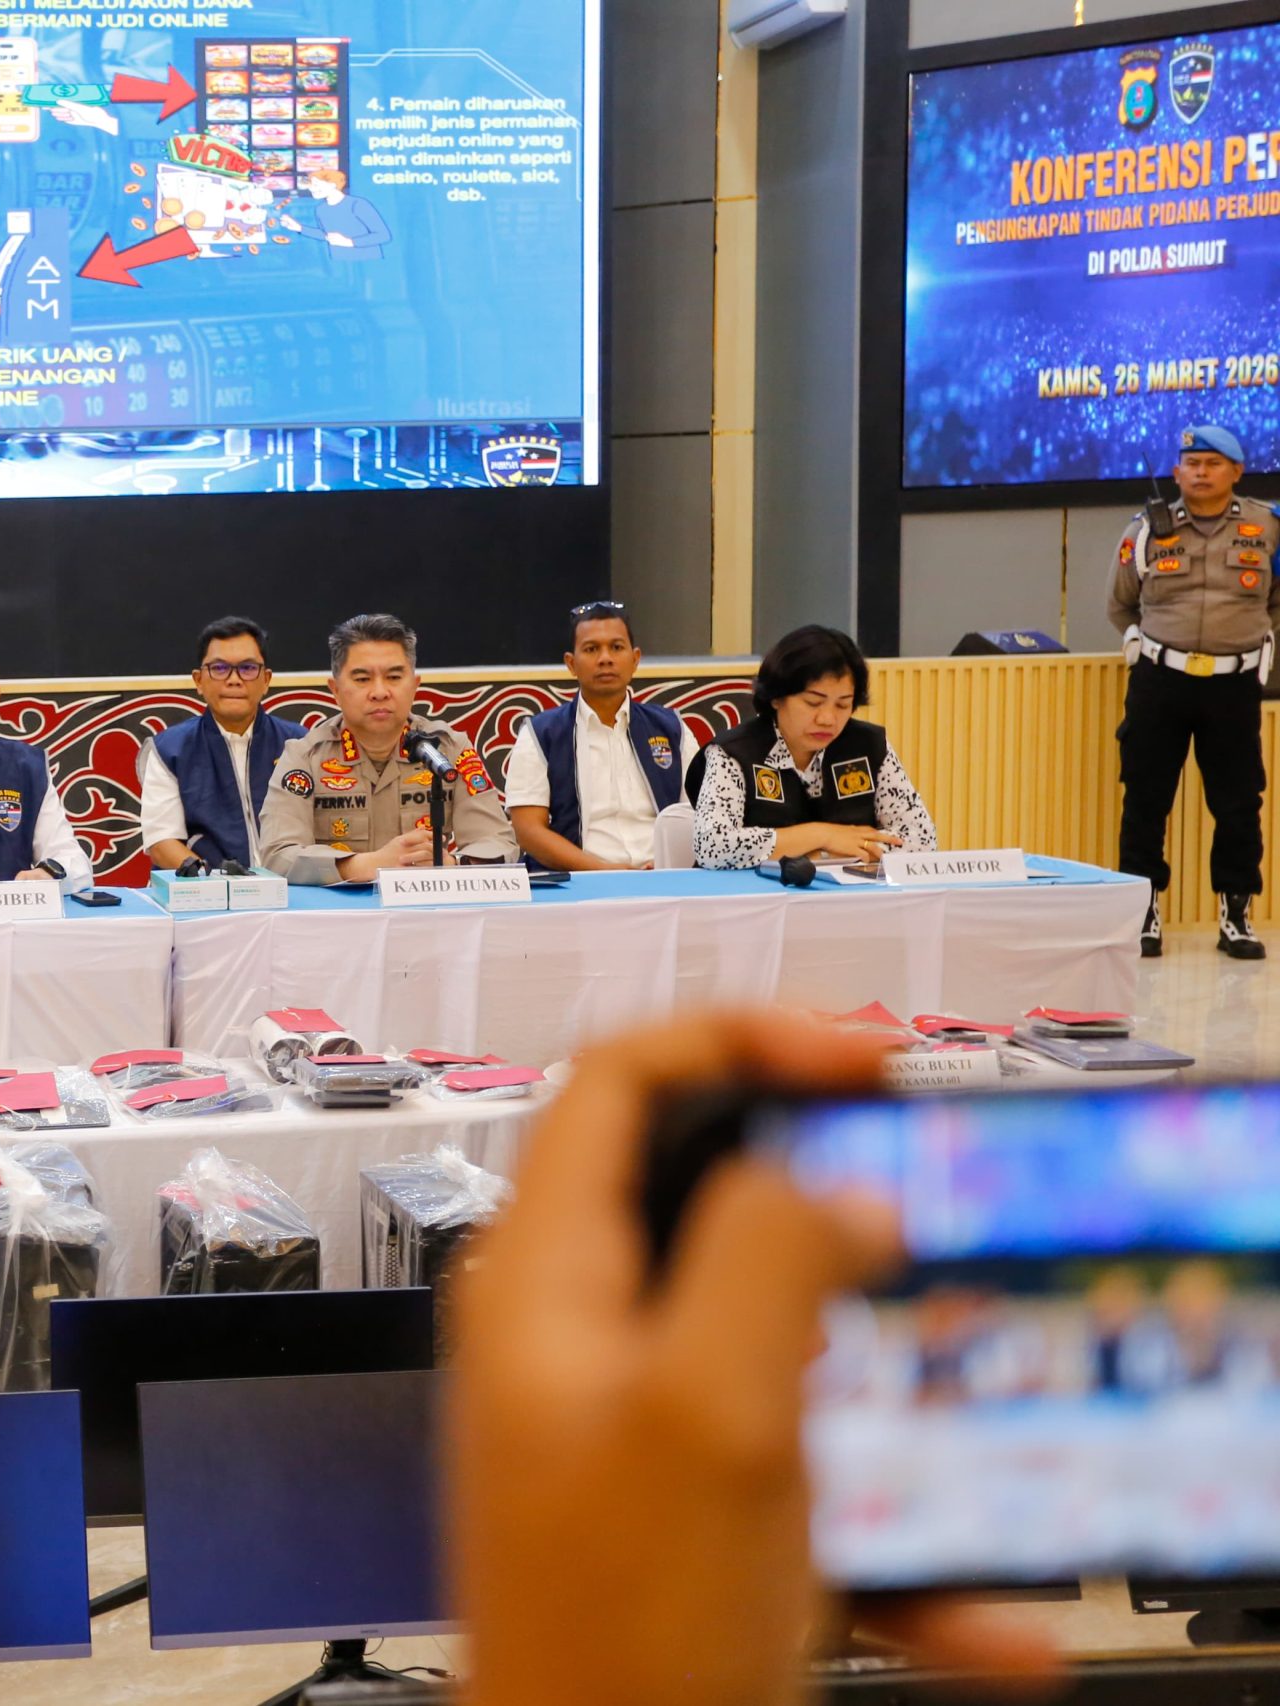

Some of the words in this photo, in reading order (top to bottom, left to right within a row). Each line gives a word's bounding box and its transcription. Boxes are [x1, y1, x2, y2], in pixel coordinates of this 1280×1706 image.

[96, 13, 144, 28] JUDI
[149, 13, 228, 28] ONLINE
[367, 98, 384, 111] 4.
[390, 97, 460, 111] Pemain
[465, 96, 565, 111] diharuskan
[356, 116, 427, 130] memilih
[431, 115, 475, 132] jenis
[480, 115, 577, 132] permainan
[369, 134, 454, 150] perjudian
[458, 133, 514, 147] online
[519, 135, 564, 149] yang
[361, 152, 406, 166] akan
[411, 151, 505, 166] dimainkan
[510, 151, 572, 167] seperti
[372, 170, 438, 185] casino,
[443, 170, 517, 184] roulette,
[521, 169, 560, 183] slot,
[1010, 140, 1212, 206] KONFERENSI
[447, 188, 486, 202] dsb.
[956, 211, 1081, 245] PENGUNGKAPAN
[1085, 206, 1144, 232] TINDAK
[1148, 198, 1211, 227] PIDANA
[1088, 251, 1105, 276] DI
[1110, 245, 1163, 273] POLDA
[1166, 239, 1228, 269] SUMUT
[27, 256, 60, 319] ATM
[43, 346, 114, 363] UANG
[1038, 365, 1108, 400] KAMIS,
[1114, 364, 1140, 395] 26
[1147, 358, 1219, 392] MARET
[1225, 353, 1280, 388] 2026
[437, 396, 532, 417] Ilustrasi
[1232, 539, 1266, 549] POLRI
[905, 862, 932, 876] KA
[934, 858, 1002, 875] LABFOR
[394, 880, 451, 894] KABID
[453, 878, 521, 892] HUMAS
[929, 1059, 972, 1071] BUKTI
[905, 1076, 945, 1087] KAMAR
